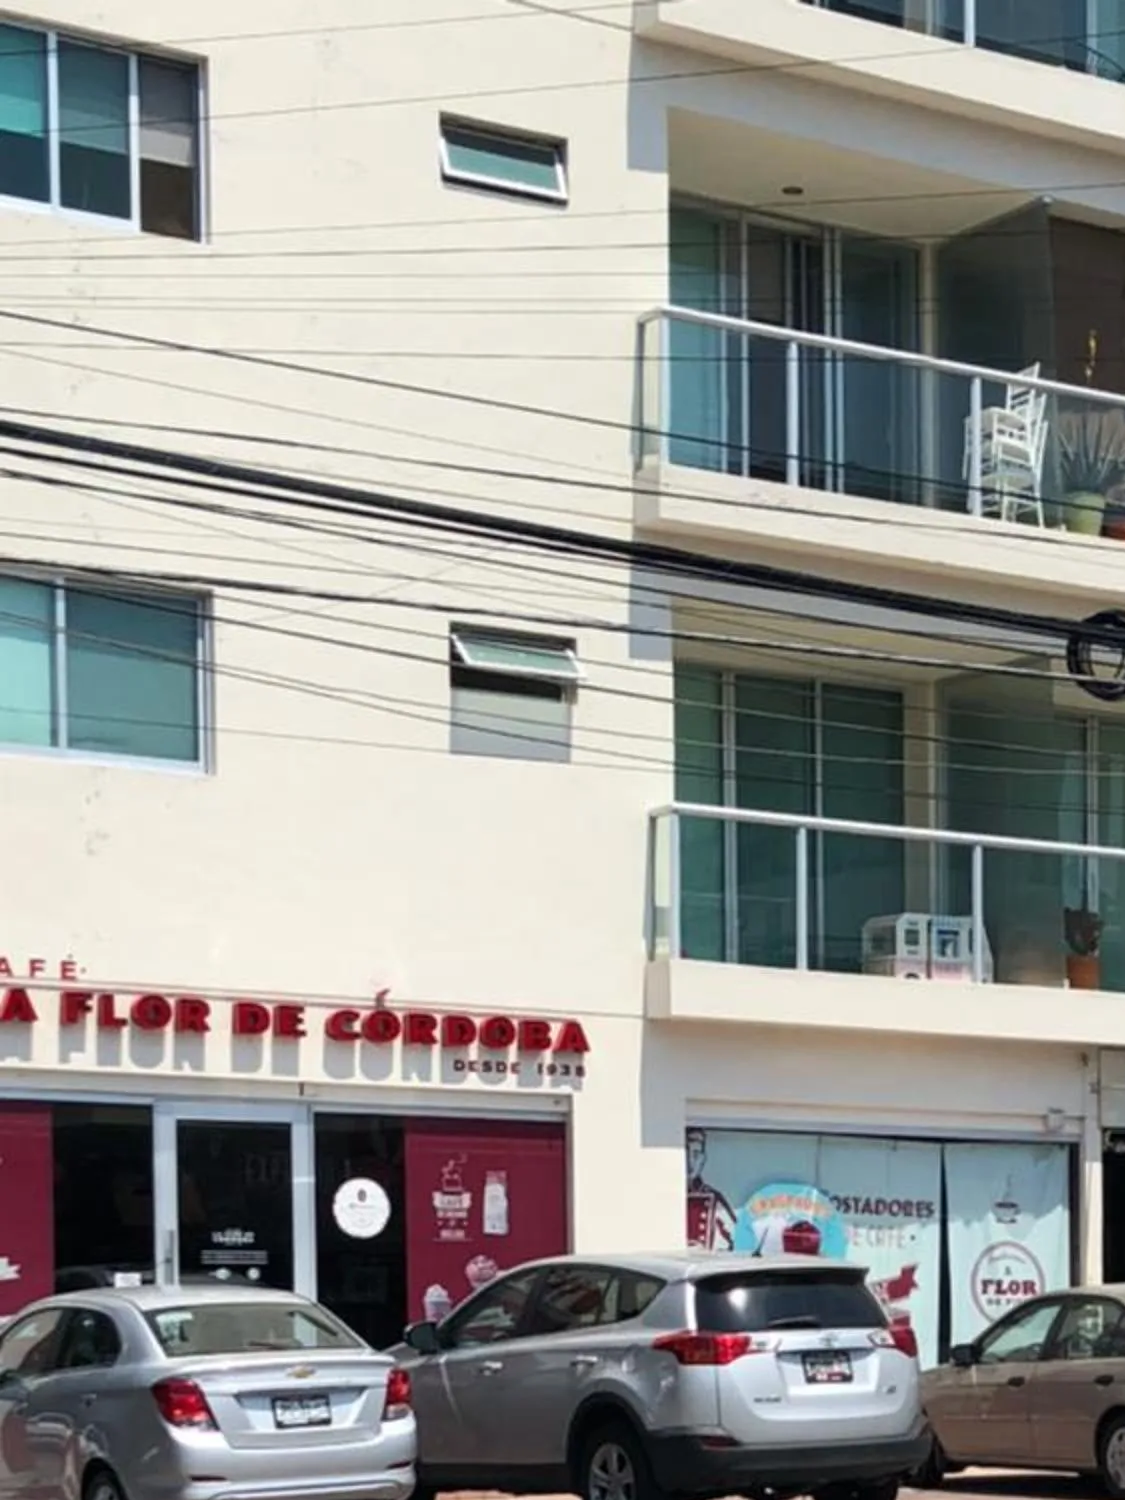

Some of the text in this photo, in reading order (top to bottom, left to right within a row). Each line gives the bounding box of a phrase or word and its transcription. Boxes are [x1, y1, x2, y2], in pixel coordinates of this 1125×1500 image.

[59, 990, 211, 1033] FLOR
[231, 1002, 307, 1037] DE
[323, 988, 591, 1052] CÓRDOBA
[453, 1059, 521, 1074] DESDE
[820, 1189, 935, 1218] OSTADORES
[981, 1279, 1037, 1296] FLOR
